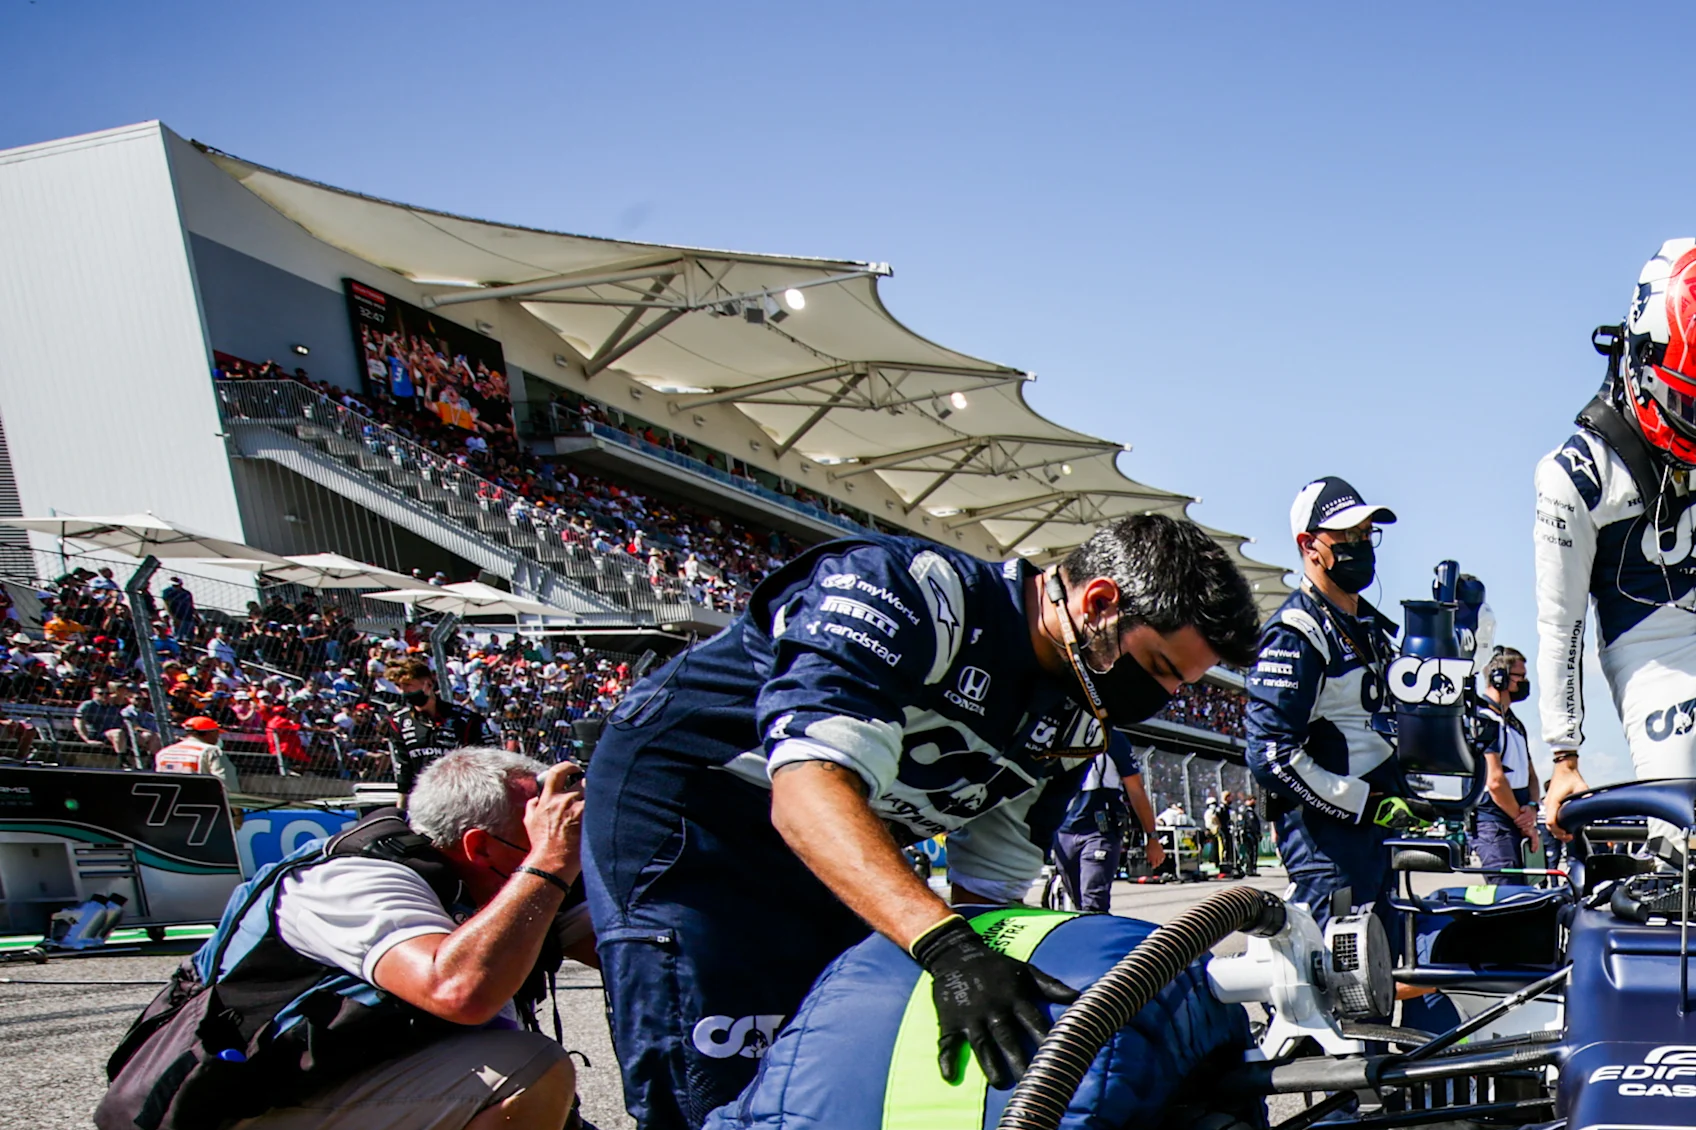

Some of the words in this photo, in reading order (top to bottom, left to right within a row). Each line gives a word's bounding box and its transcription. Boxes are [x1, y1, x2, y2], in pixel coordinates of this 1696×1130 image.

[819, 595, 900, 639] PIRELLI
[856, 579, 921, 626] myWorld
[823, 621, 903, 668] randstad
[132, 783, 221, 846] 77
[944, 969, 972, 1007] HyFlex
